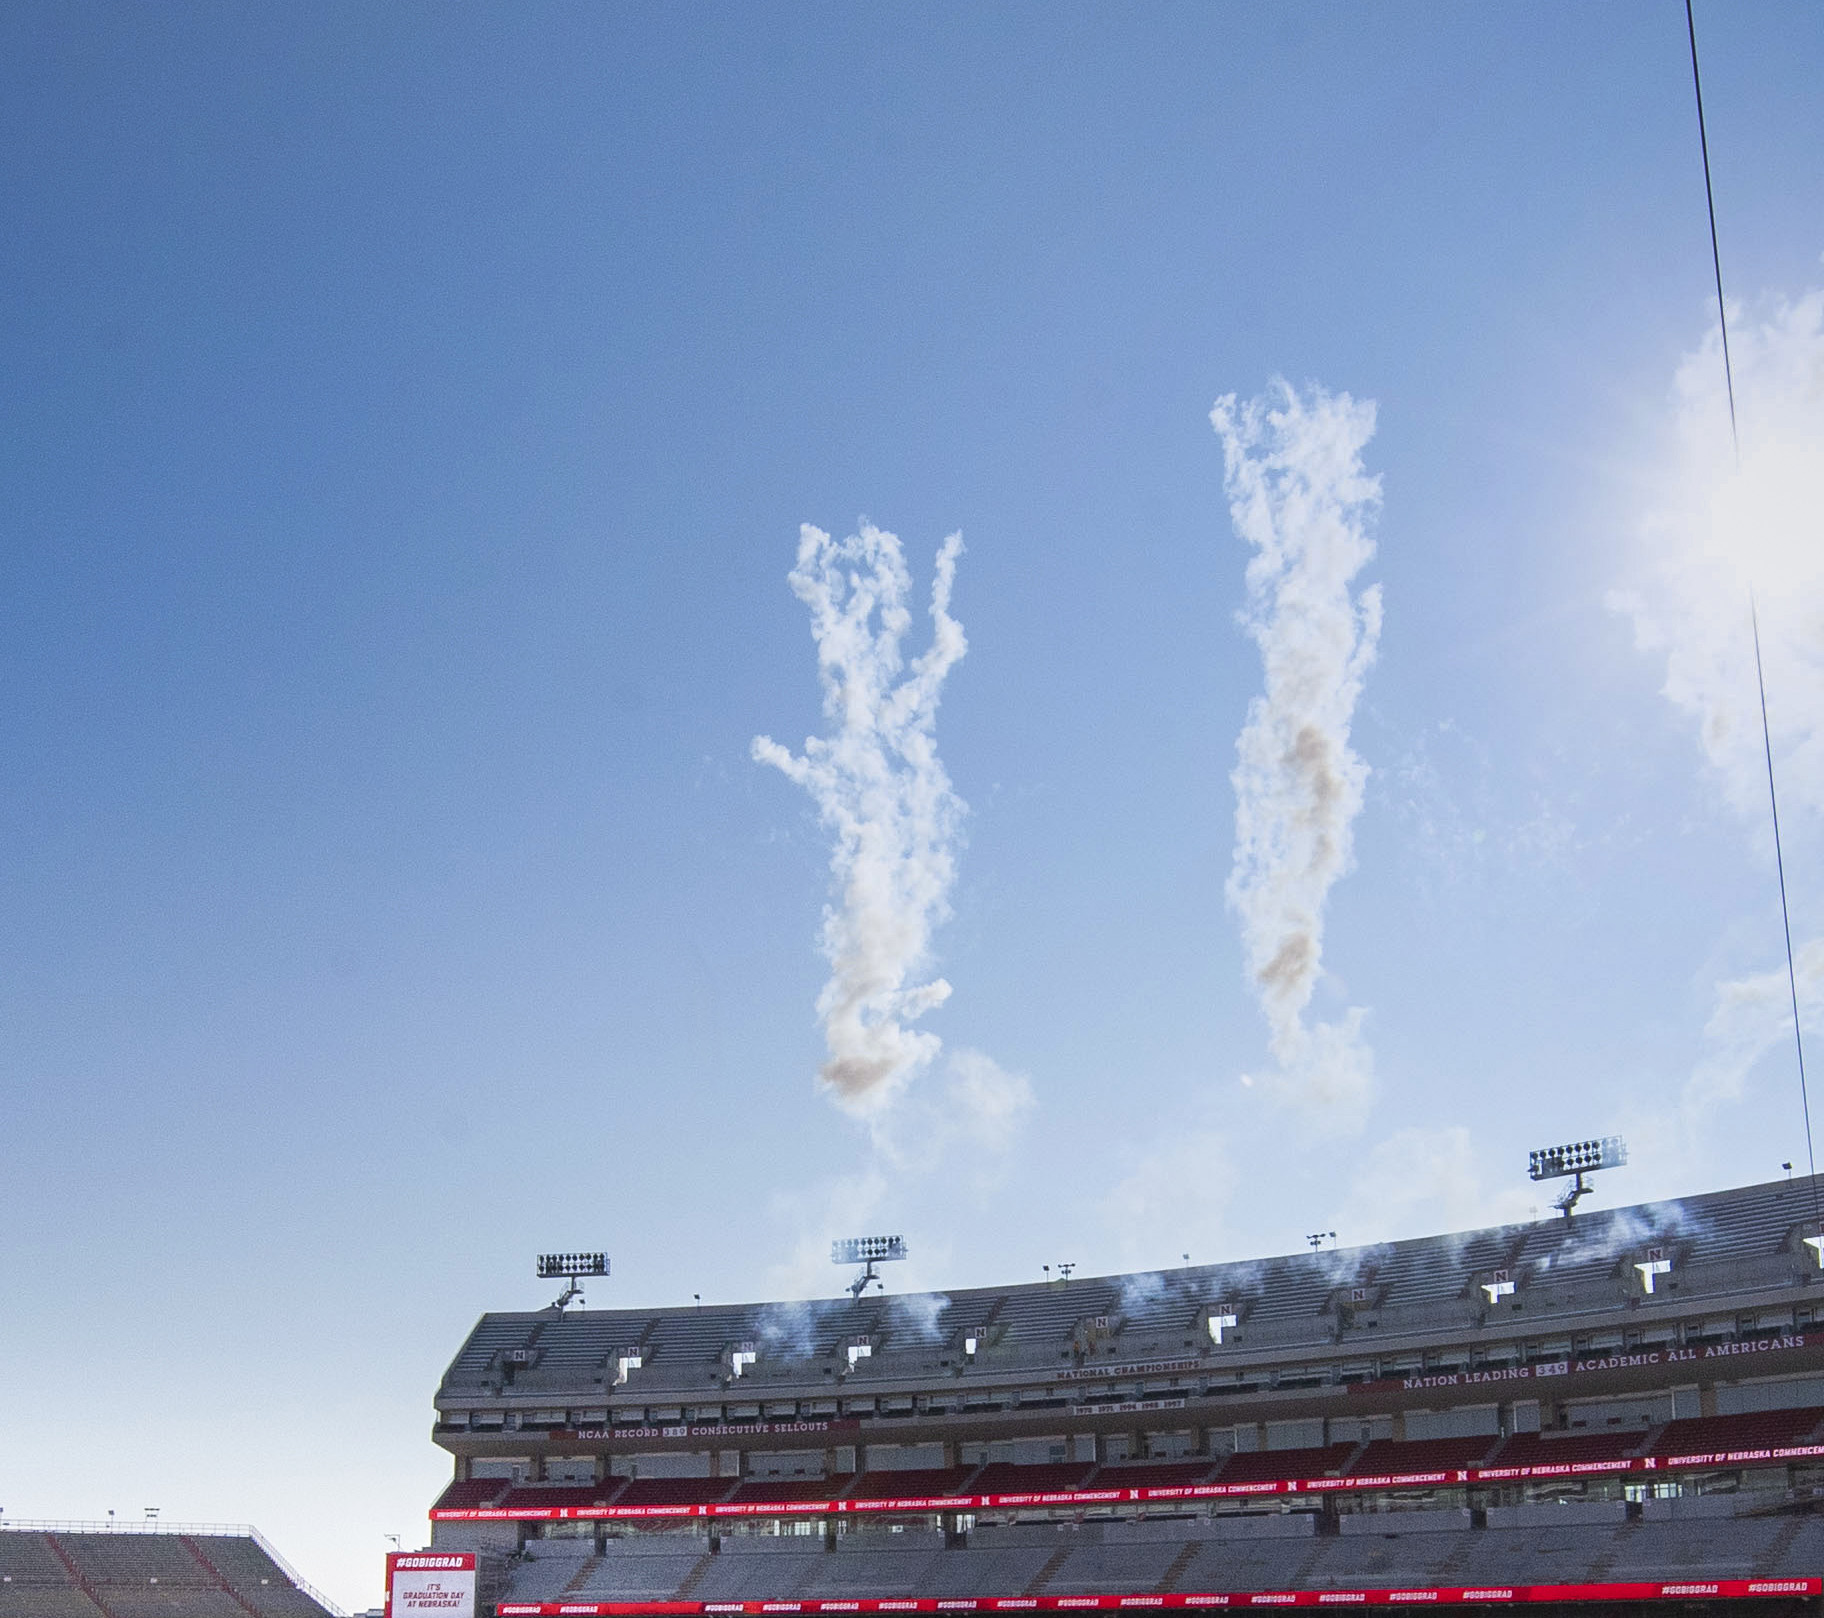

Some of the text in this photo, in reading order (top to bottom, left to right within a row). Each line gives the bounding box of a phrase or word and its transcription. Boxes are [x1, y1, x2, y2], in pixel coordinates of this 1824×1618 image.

[1496, 1272, 1506, 1280] N
[1354, 1290, 1364, 1299] N
[1098, 1318, 1106, 1326] N
[1404, 1336, 1804, 1389] NATION LEADING 349 ACADEMIC ALL AMERICANS
[1057, 1360, 1200, 1378] NATIONAL CHAMPIONSHIPS
[578, 1428, 609, 1439] NCAA
[614, 1426, 659, 1438] RECORD
[691, 1422, 769, 1436] CONSECUTIVE
[774, 1420, 828, 1433] SELLOUTS
[1644, 1458, 1656, 1468] N
[1668, 1454, 1714, 1465] UNIVERSITY
[1715, 1453, 1725, 1462] OF
[1727, 1450, 1771, 1460] NEBRASKA
[1458, 1471, 1467, 1481] N
[1478, 1468, 1519, 1478] UNIVERSITY
[1532, 1465, 1570, 1474] NEBRASKA
[1572, 1460, 1631, 1472] COMMENCEMENT
[1288, 1482, 1297, 1491] N
[1307, 1480, 1344, 1488] UNIVERSITY
[1356, 1477, 1390, 1485] NEBRASKA
[1392, 1473, 1445, 1483] COMMENCEMENT
[1130, 1490, 1139, 1499] N
[1148, 1488, 1183, 1496] UNIVERSITY
[1194, 1486, 1226, 1494] NEBRASKA
[1228, 1483, 1277, 1493] COMMENCEMENT
[396, 1557, 463, 1568] #GOBIGGRAD
[427, 1583, 441, 1591] IT'S
[1662, 1585, 1718, 1594] #GOBIGGRAD
[1748, 1582, 1808, 1592] #GOBIGGRAD
[402, 1592, 448, 1600] GRADUATION
[1462, 1590, 1512, 1599] #GOBIGGRAD
[418, 1600, 460, 1608] NEBRASKA!
